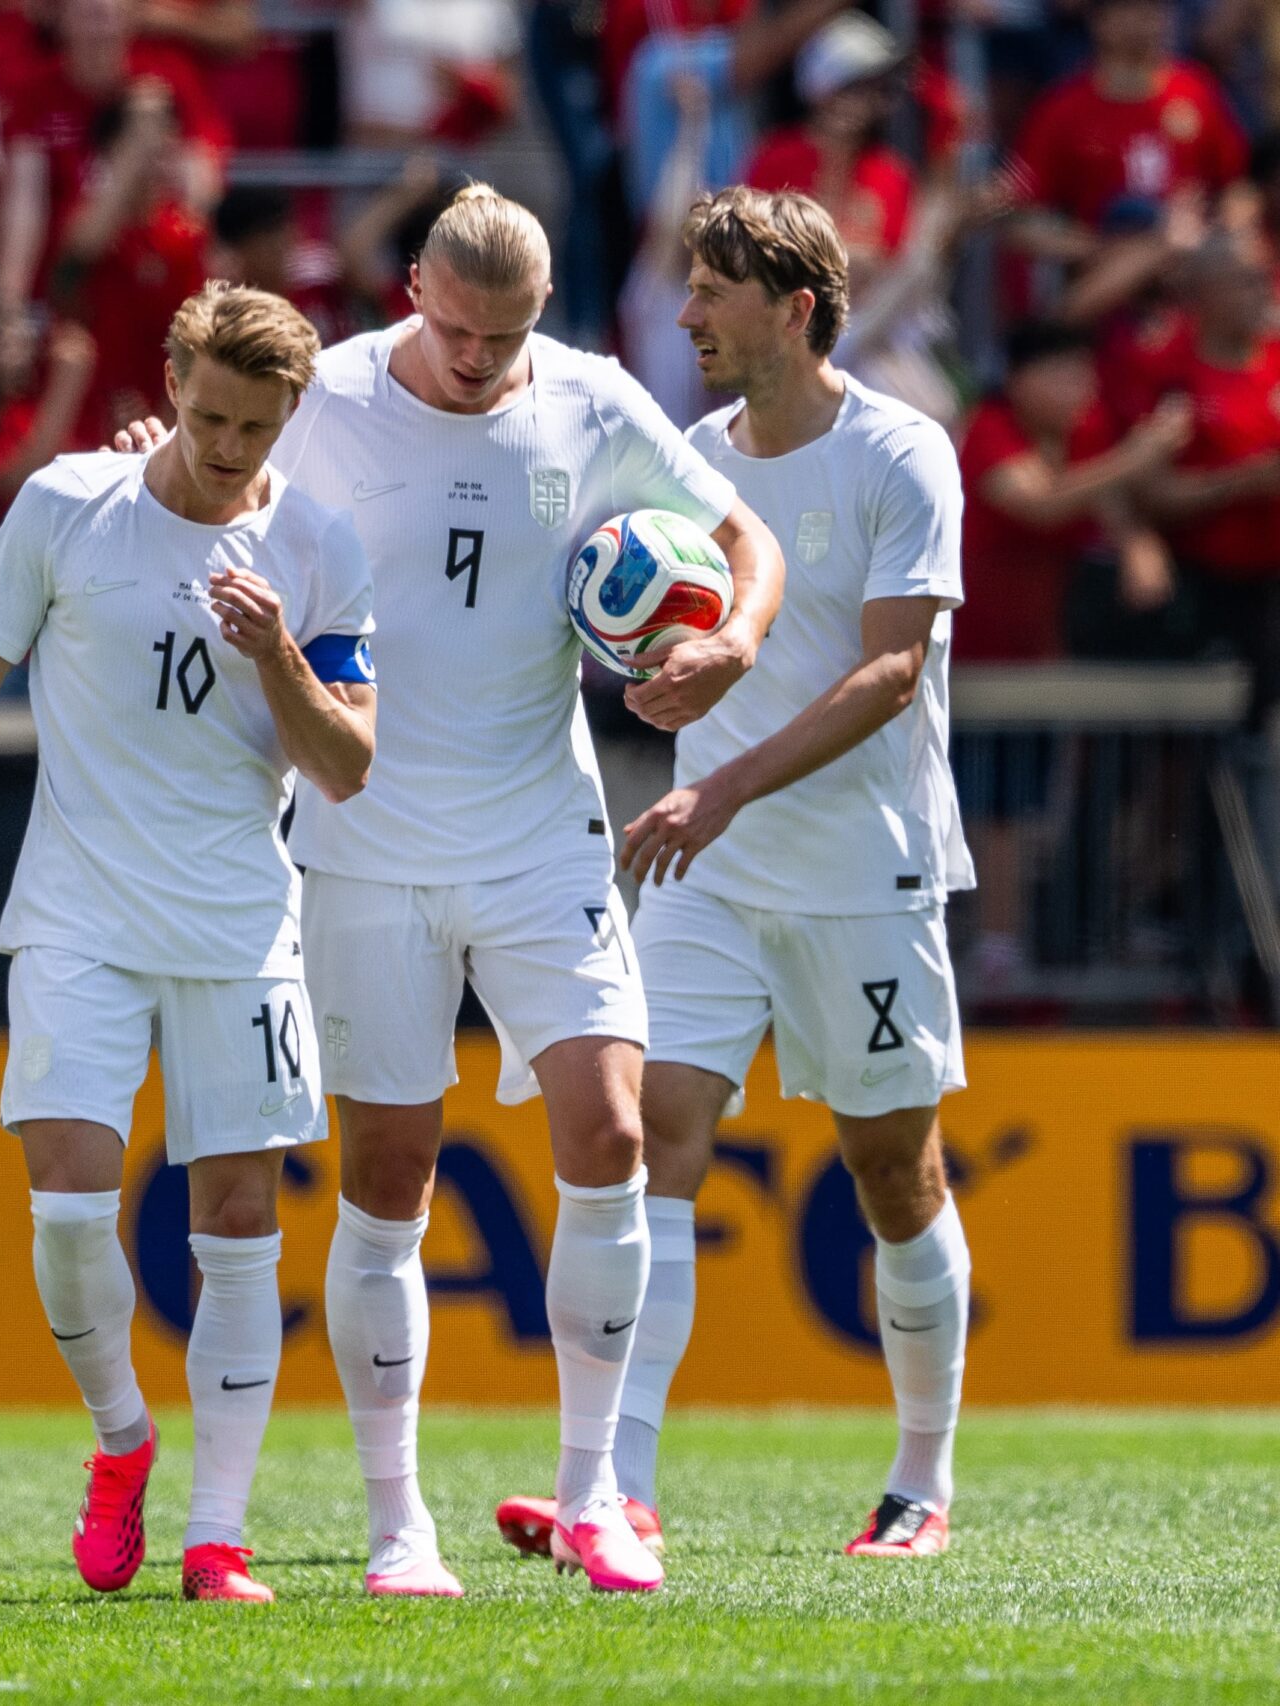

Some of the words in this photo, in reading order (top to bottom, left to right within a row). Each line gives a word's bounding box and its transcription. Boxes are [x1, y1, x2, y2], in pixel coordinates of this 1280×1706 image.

[445, 528, 484, 609] 9
[153, 631, 216, 715] 10
[252, 1000, 301, 1082] 10
[861, 978, 905, 1053] 8
[1128, 1136, 1280, 1348] B
